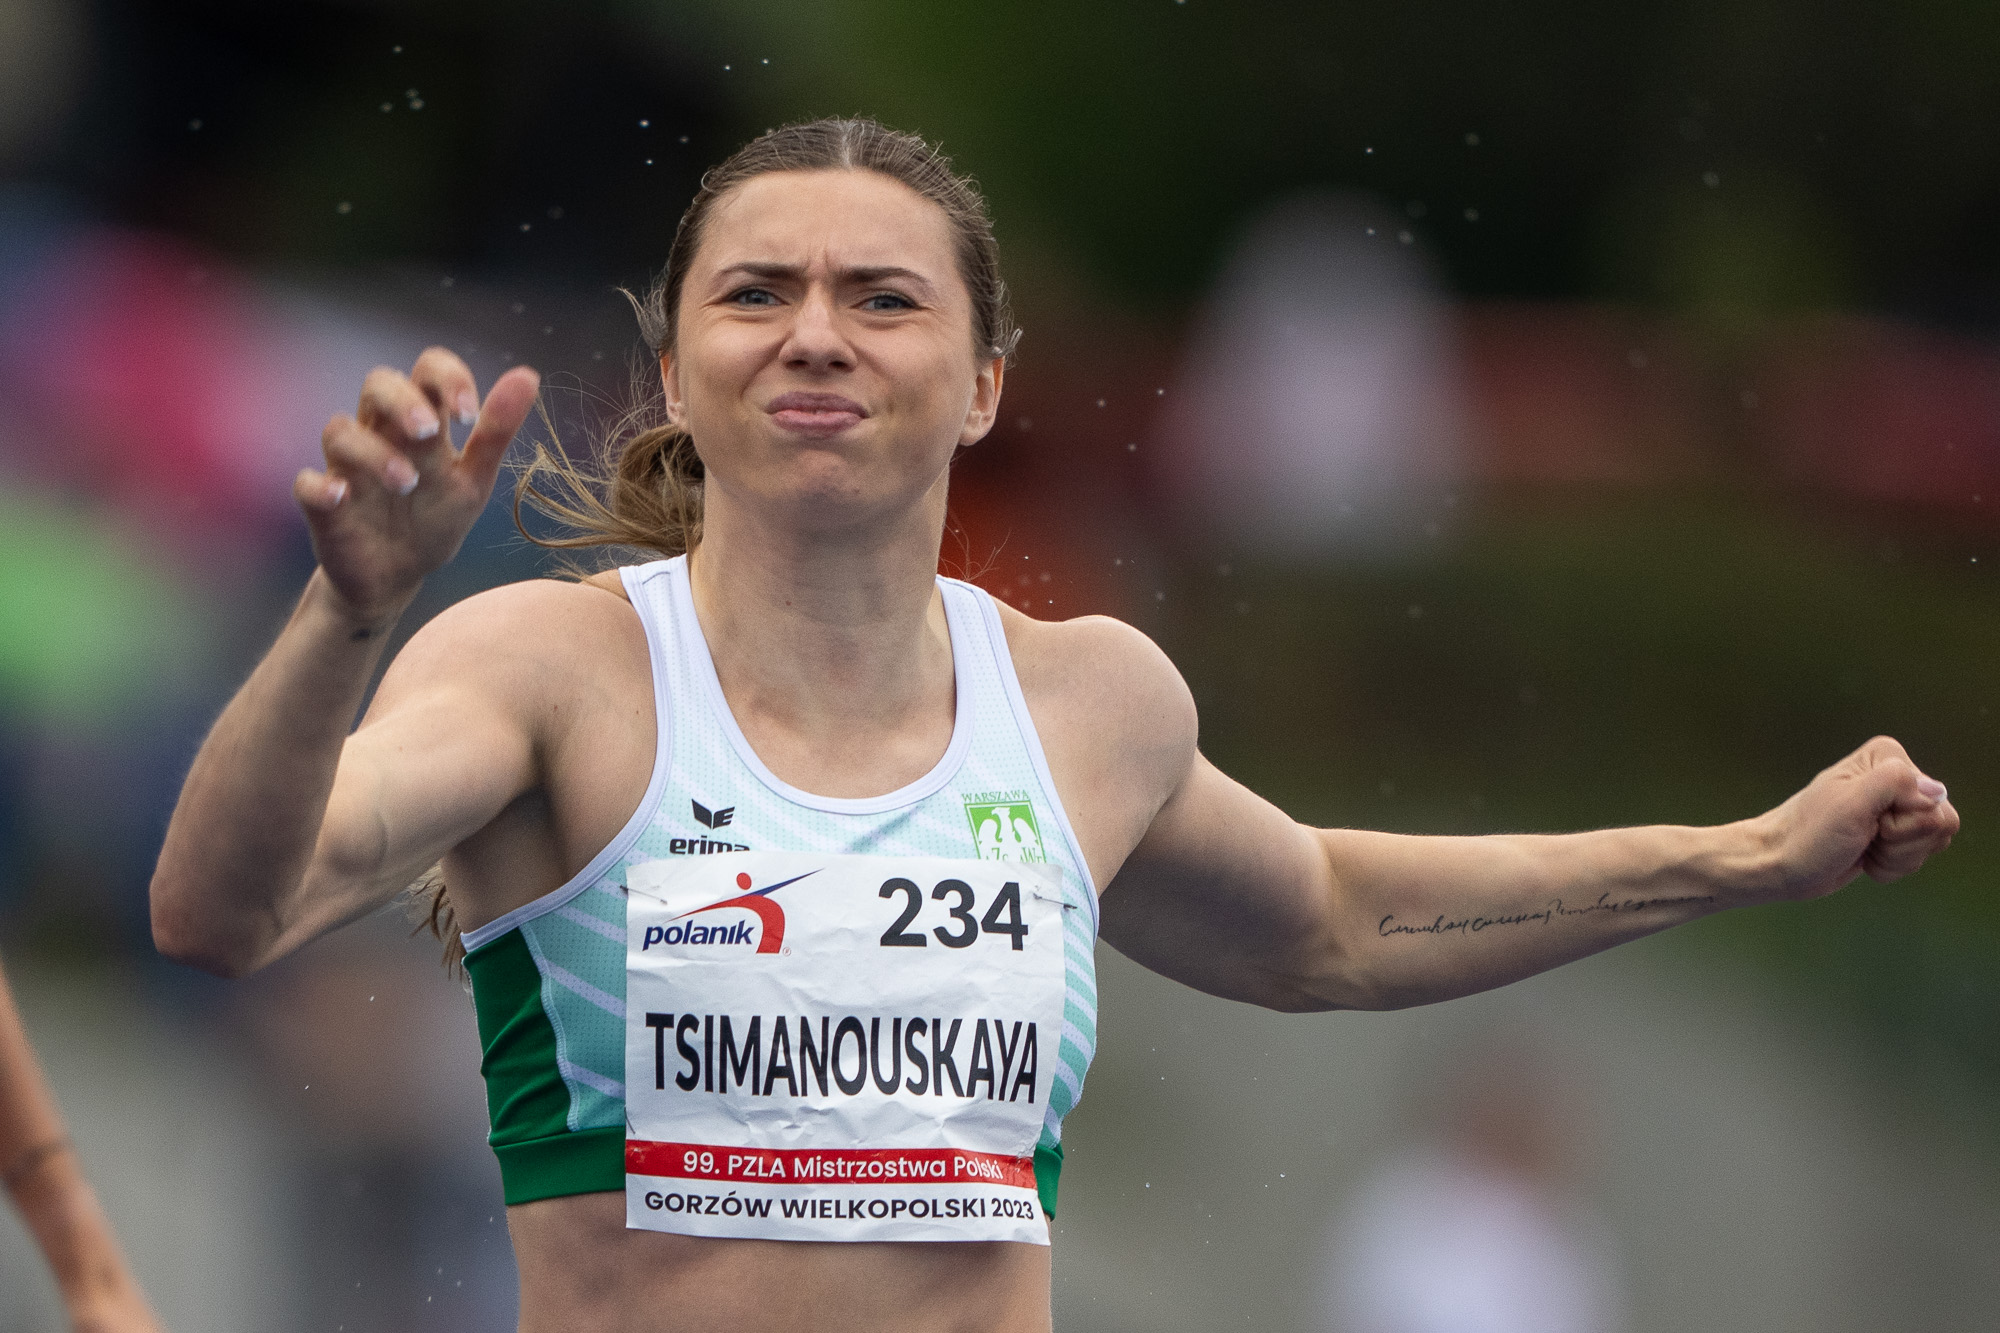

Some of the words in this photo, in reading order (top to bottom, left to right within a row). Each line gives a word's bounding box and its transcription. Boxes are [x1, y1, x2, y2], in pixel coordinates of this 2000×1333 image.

[961, 789, 1030, 803] WARSZAWA
[878, 877, 1029, 951] 234
[642, 919, 755, 951] polanik
[645, 1012, 1038, 1104] TSIMANOUSKAYA
[683, 1151, 720, 1175] 99.
[728, 1155, 786, 1178] PZLA
[794, 1155, 947, 1180] Mistrzostwa
[954, 1156, 1003, 1180] Polski
[645, 1191, 773, 1218] GORZÓW
[780, 1198, 987, 1219] WIELKOPOLSKI
[991, 1197, 1035, 1220] 2023
